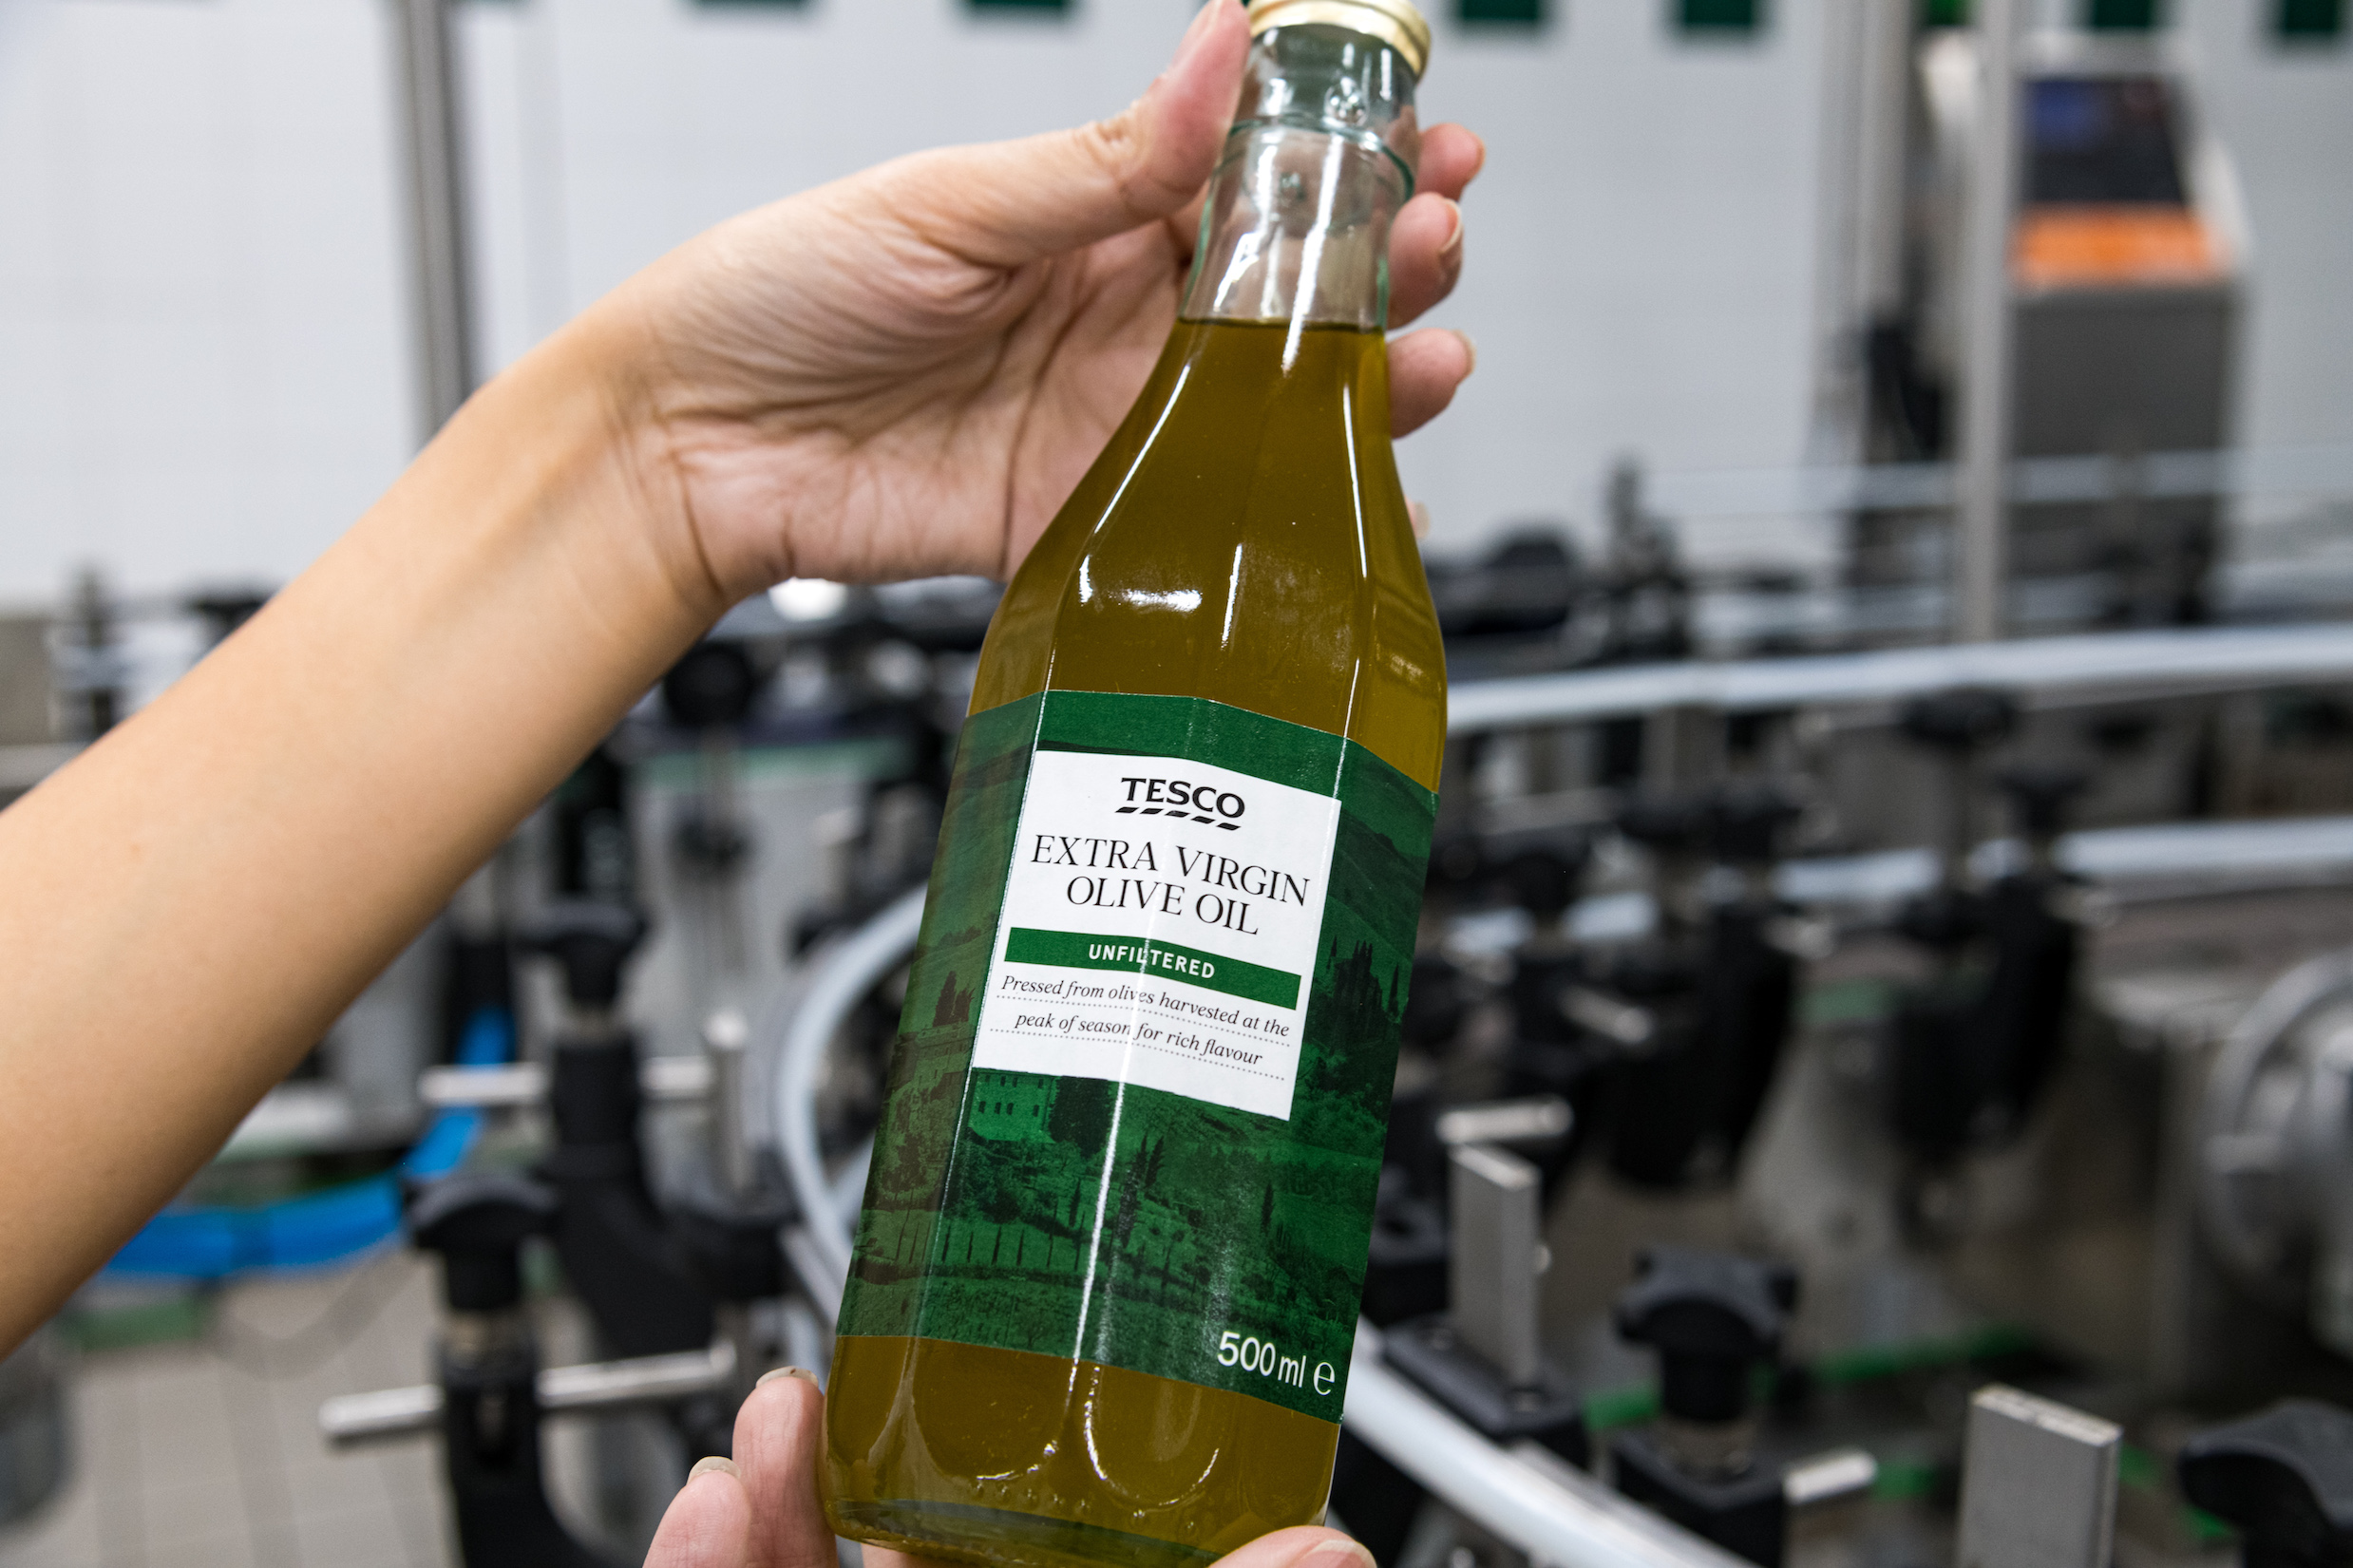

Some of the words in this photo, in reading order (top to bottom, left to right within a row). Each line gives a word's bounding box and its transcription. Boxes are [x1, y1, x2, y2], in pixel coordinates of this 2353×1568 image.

[1121, 777, 1245, 819] TESCO
[1031, 834, 1159, 872] EXTRA
[1175, 844, 1311, 907] VIRGIN
[1067, 876, 1186, 916] OLIVE
[1195, 893, 1260, 935] OIL
[1089, 943, 1215, 979] UNFILTERED
[1001, 974, 1065, 995] Pressed
[1062, 980, 1105, 1000] from
[1108, 984, 1155, 1005] olives
[1159, 992, 1241, 1026] harvested
[1243, 1015, 1262, 1030] at
[1263, 1018, 1290, 1037] the
[1014, 1012, 1056, 1030] peak
[1058, 1014, 1079, 1034] of
[1078, 1019, 1132, 1036] season
[1132, 1022, 1164, 1041] for
[1167, 1031, 1201, 1051] rich
[1199, 1038, 1263, 1066] flavour
